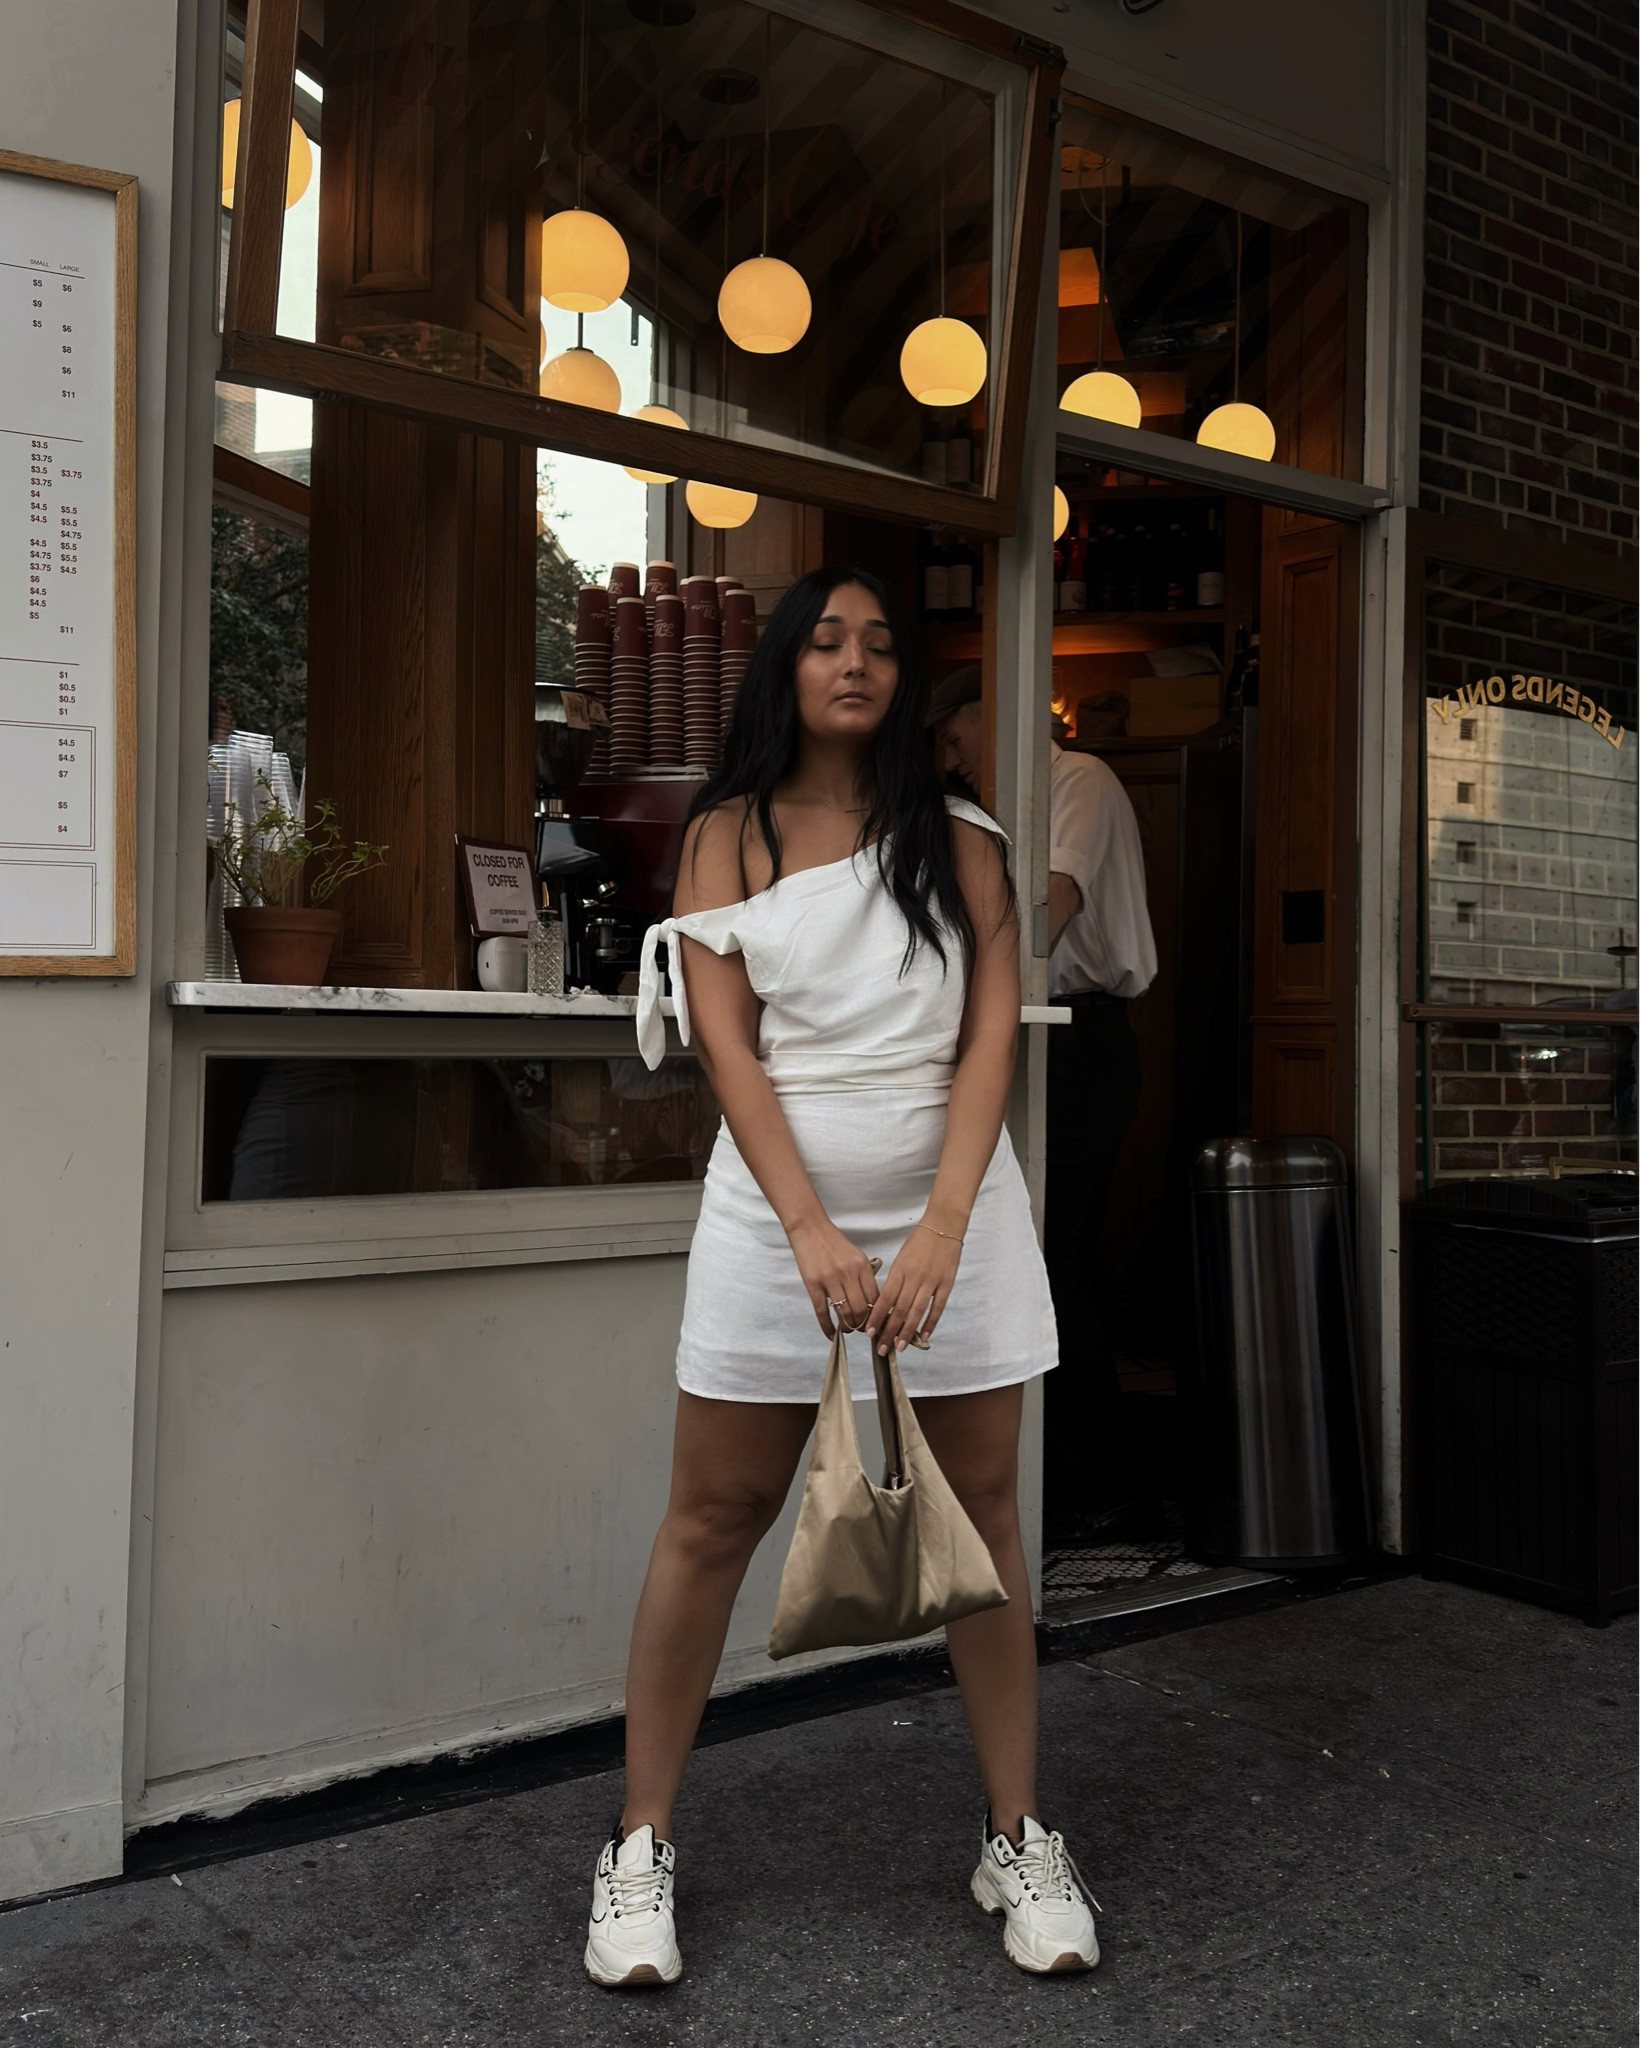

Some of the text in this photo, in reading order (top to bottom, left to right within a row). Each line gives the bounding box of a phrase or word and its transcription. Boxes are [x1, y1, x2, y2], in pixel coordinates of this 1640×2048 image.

[29, 258, 80, 273] SMALL LARGE
[32, 278, 73, 293] $5 $6
[32, 299, 43, 308] $9
[32, 319, 73, 333] $5 $6
[61, 345, 72, 354] $8
[61, 366, 72, 376] $6
[61, 389, 76, 399] $11
[30, 439, 49, 450] $3.5
[30, 453, 53, 464] $3.75
[30, 465, 83, 480] $3.5 $3.75
[30, 477, 53, 488] $3.75
[30, 489, 41, 499] $4
[30, 501, 78, 515] $4.5 $5.5
[29, 513, 78, 528] $4.5 $5.5
[60, 529, 83, 540] $4.75
[29, 538, 78, 552] $4.5 $5.5
[29, 549, 78, 563] $4.75 $5.5
[29, 562, 78, 575] $3.75 $4.5
[29, 574, 41, 584] $6
[29, 586, 48, 596] $4.5
[29, 598, 47, 608] $4.5
[28, 610, 40, 620] $5
[59, 625, 74, 635] $11
[58, 670, 69, 680] $1
[58, 682, 77, 692] $0.5
[58, 694, 76, 704] $0.5
[58, 707, 68, 716] $1
[57, 738, 76, 747] $4.5
[57, 753, 76, 763] $4.5
[58, 769, 69, 779] $7
[57, 800, 69, 810] $5
[57, 824, 68, 833] $4
[472, 853, 525, 870] CLOSED FOR
[487, 873, 519, 889] COFFEE
